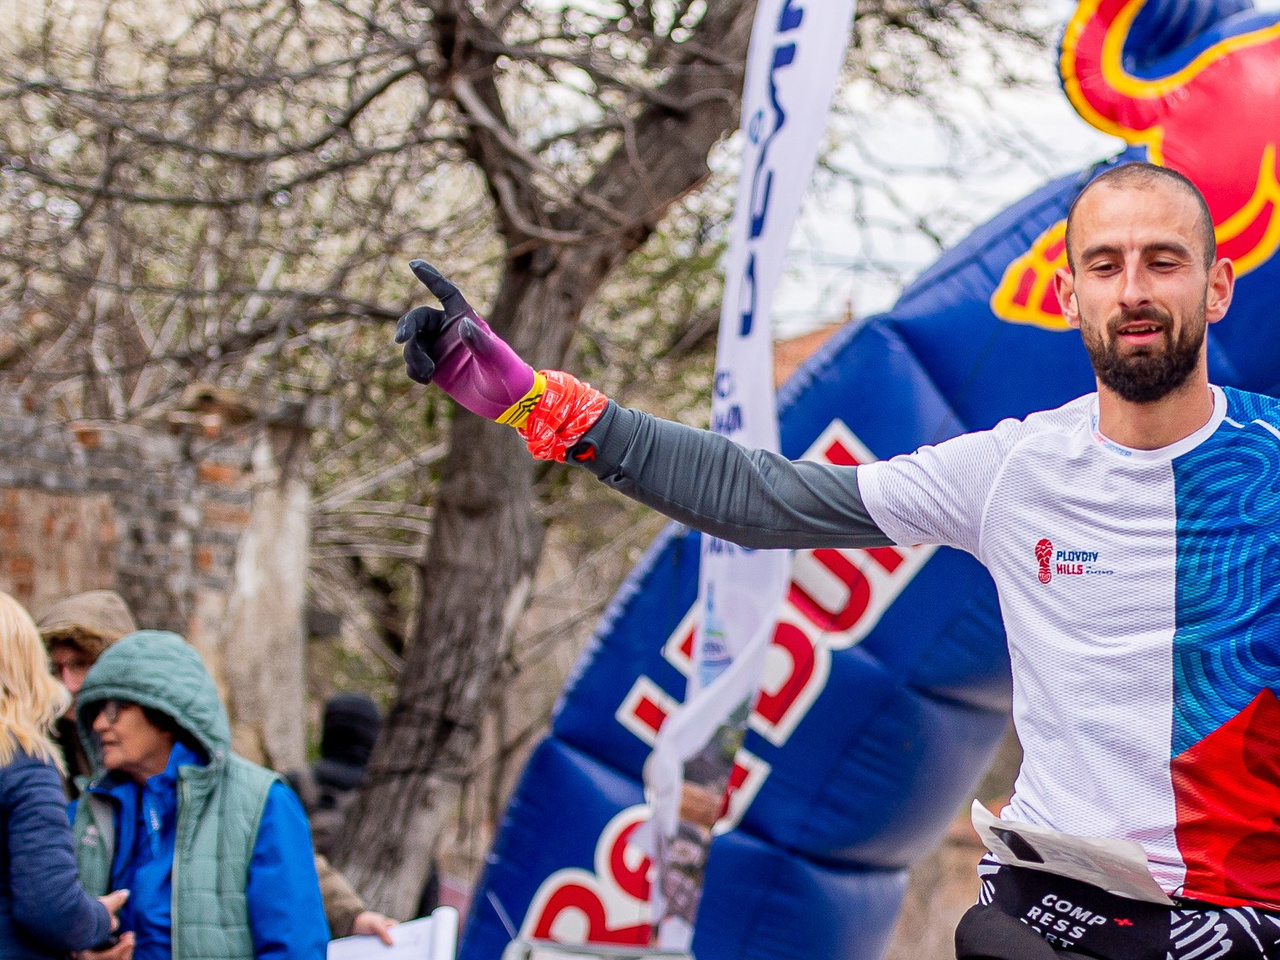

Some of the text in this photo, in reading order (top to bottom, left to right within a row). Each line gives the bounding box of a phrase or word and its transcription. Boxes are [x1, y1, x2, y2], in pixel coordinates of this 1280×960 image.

[1056, 550, 1099, 562] PLOVDIV
[1056, 563, 1083, 575] HILLS
[1041, 894, 1107, 926] COMP
[1026, 905, 1086, 939] RESS
